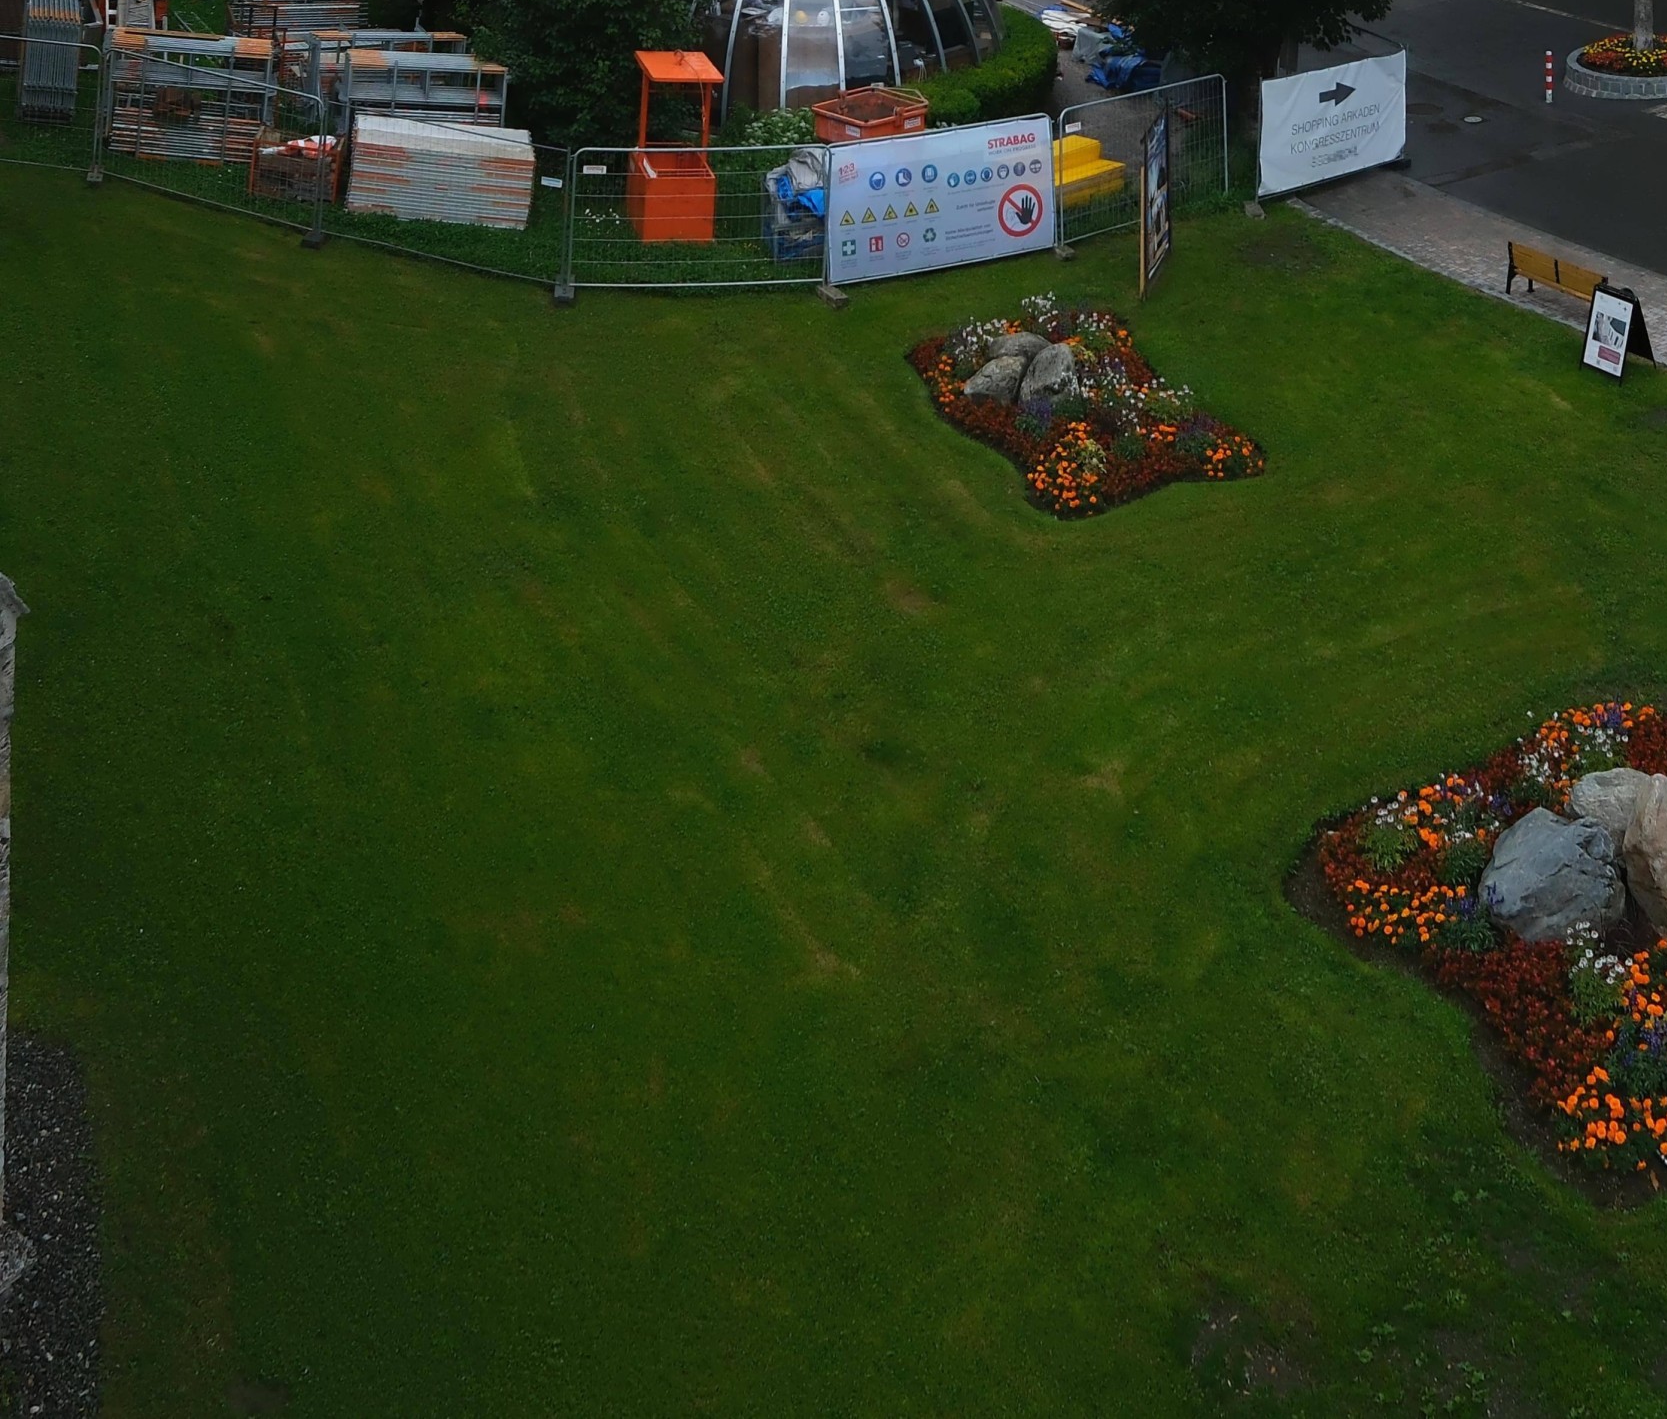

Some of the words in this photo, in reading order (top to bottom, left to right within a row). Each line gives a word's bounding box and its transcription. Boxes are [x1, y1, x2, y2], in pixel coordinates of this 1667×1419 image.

[1291, 114, 1339, 136] SHOPPING
[1341, 103, 1380, 124] ARKADEN
[987, 133, 1036, 149] STRABAG
[1290, 121, 1380, 155] KONGRESSZENTRUM
